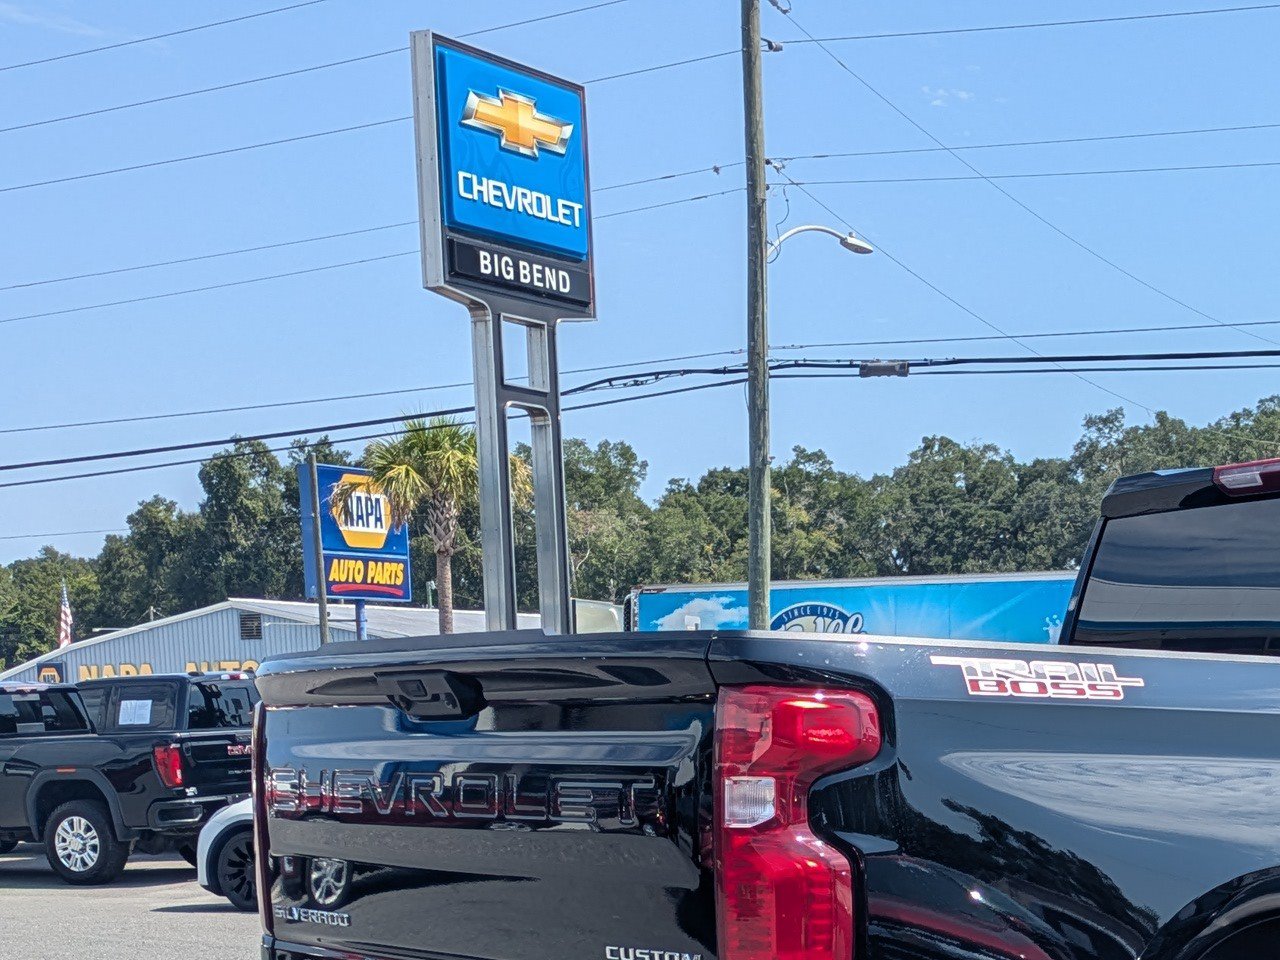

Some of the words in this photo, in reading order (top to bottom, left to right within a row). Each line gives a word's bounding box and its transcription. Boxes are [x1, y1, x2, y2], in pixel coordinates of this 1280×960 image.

[457, 170, 583, 229] CHEVROLET
[479, 250, 514, 281] BIG
[519, 260, 571, 294] BEND
[343, 493, 384, 530] NAPA
[328, 558, 365, 583] AUTO
[366, 560, 405, 586] PARTS
[782, 606, 811, 622] SINCE
[929, 655, 1145, 687] TRAIL
[967, 677, 1125, 701] BOSS
[270, 766, 659, 826] CHEVROLET
[273, 903, 351, 928] SILVERADO
